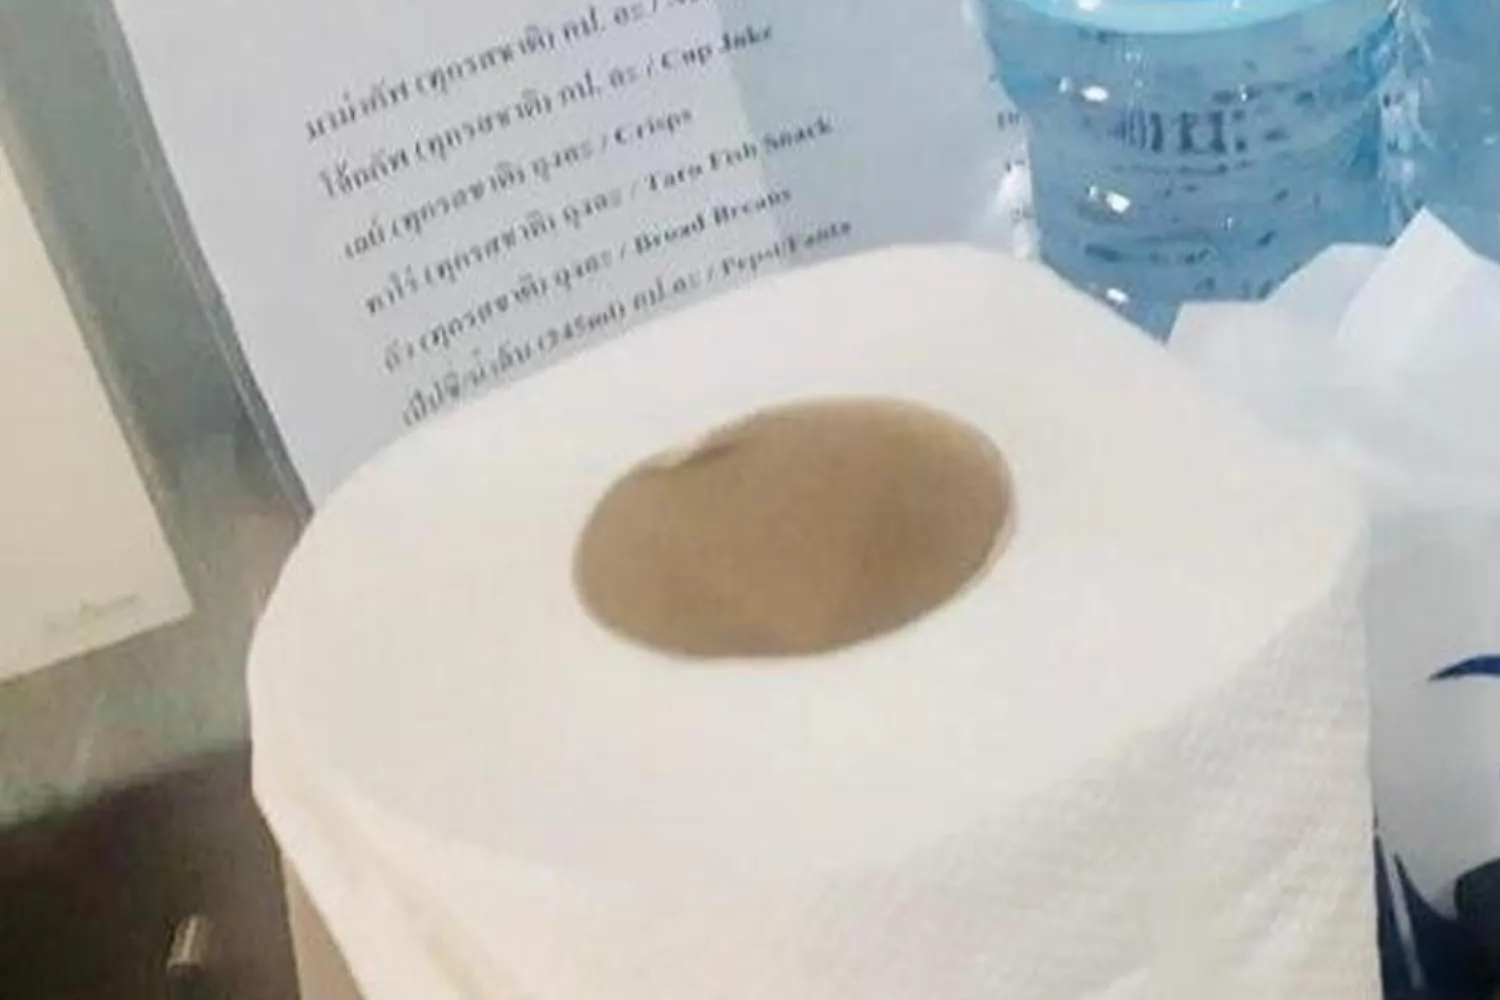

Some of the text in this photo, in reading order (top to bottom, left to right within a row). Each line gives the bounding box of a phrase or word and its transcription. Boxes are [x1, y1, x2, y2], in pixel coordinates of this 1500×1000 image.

[661, 44, 713, 70] Cup
[614, 107, 693, 144] Crisps
[643, 163, 703, 191] Taro
[762, 115, 834, 153] Snack
